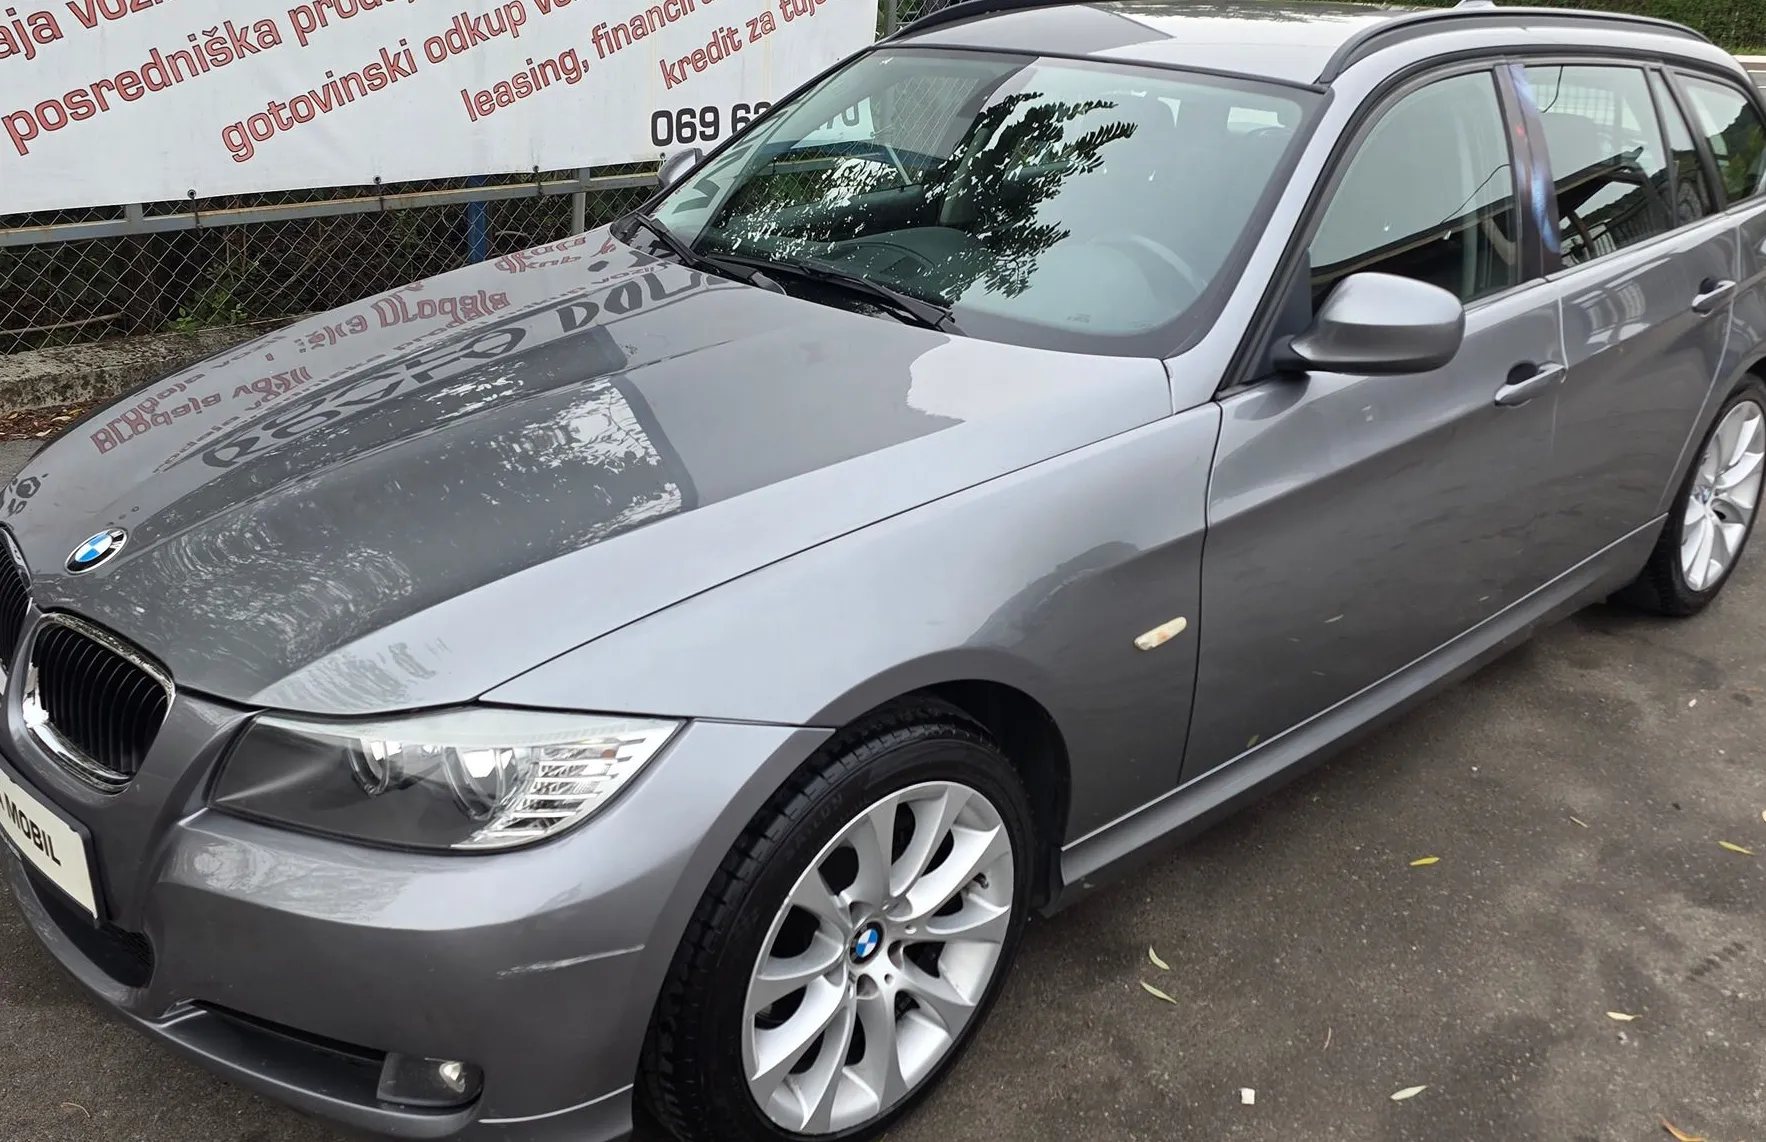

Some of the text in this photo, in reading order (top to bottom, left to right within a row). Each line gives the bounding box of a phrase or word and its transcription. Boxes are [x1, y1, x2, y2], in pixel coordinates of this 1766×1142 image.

[1, 20, 283, 156] posredniška
[221, 0, 527, 163] gotovinski odkup
[461, 48, 590, 122] leasing,
[659, 26, 743, 90] kredit
[746, 11, 776, 43] za
[651, 106, 720, 146] 069
[4, 792, 61, 866] MOBIL
